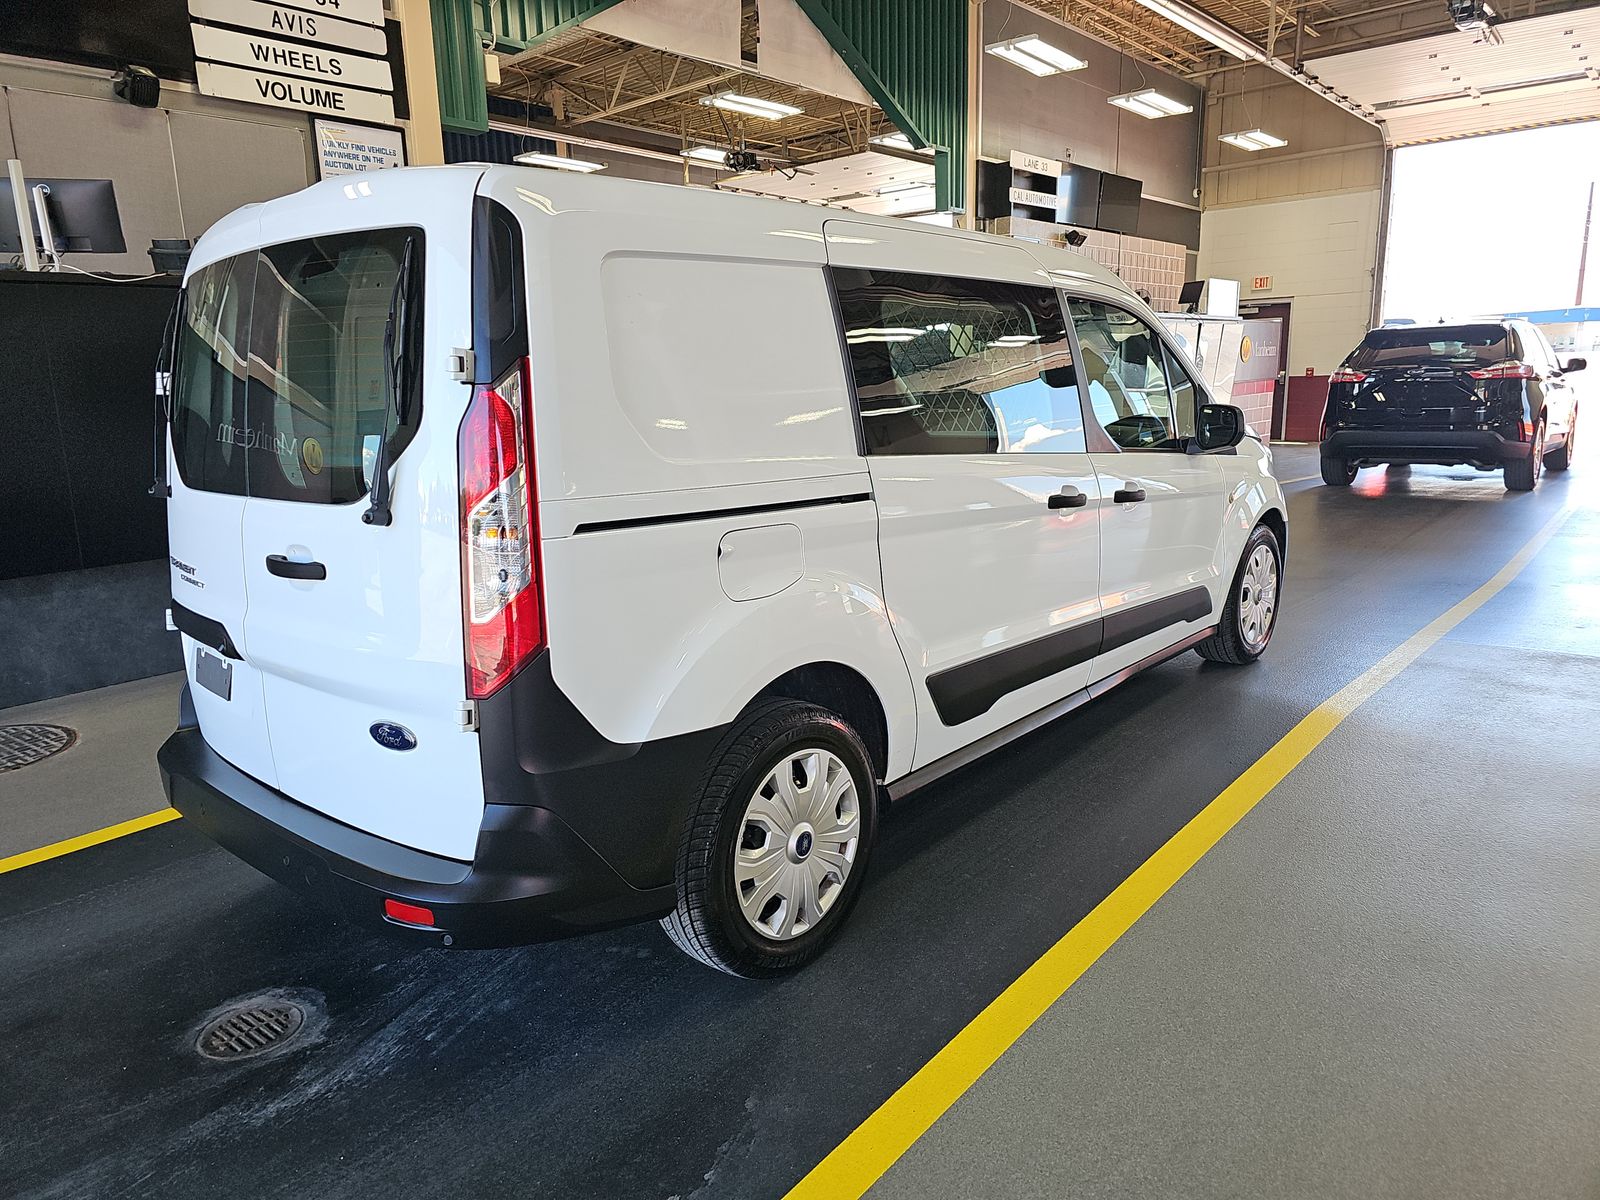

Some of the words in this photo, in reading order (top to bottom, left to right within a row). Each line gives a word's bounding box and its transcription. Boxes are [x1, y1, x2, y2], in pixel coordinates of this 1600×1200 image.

[271, 10, 317, 37] AVIS
[249, 42, 342, 76] WHEELS
[255, 78, 345, 111] VOLUME
[323, 149, 361, 161] ANYWHERE
[361, 154, 372, 163] ON
[372, 156, 385, 165] THE
[351, 143, 366, 153] FIND
[367, 145, 397, 157] VEHICLES
[324, 159, 354, 171] AUCTION
[354, 164, 367, 172] LOT
[1023, 157, 1039, 170] LANE
[1040, 162, 1048, 172] 33
[1024, 192, 1057, 208] AUTOMOTIVE
[1254, 276, 1270, 289] EXIT
[376, 726, 402, 747] Ford
